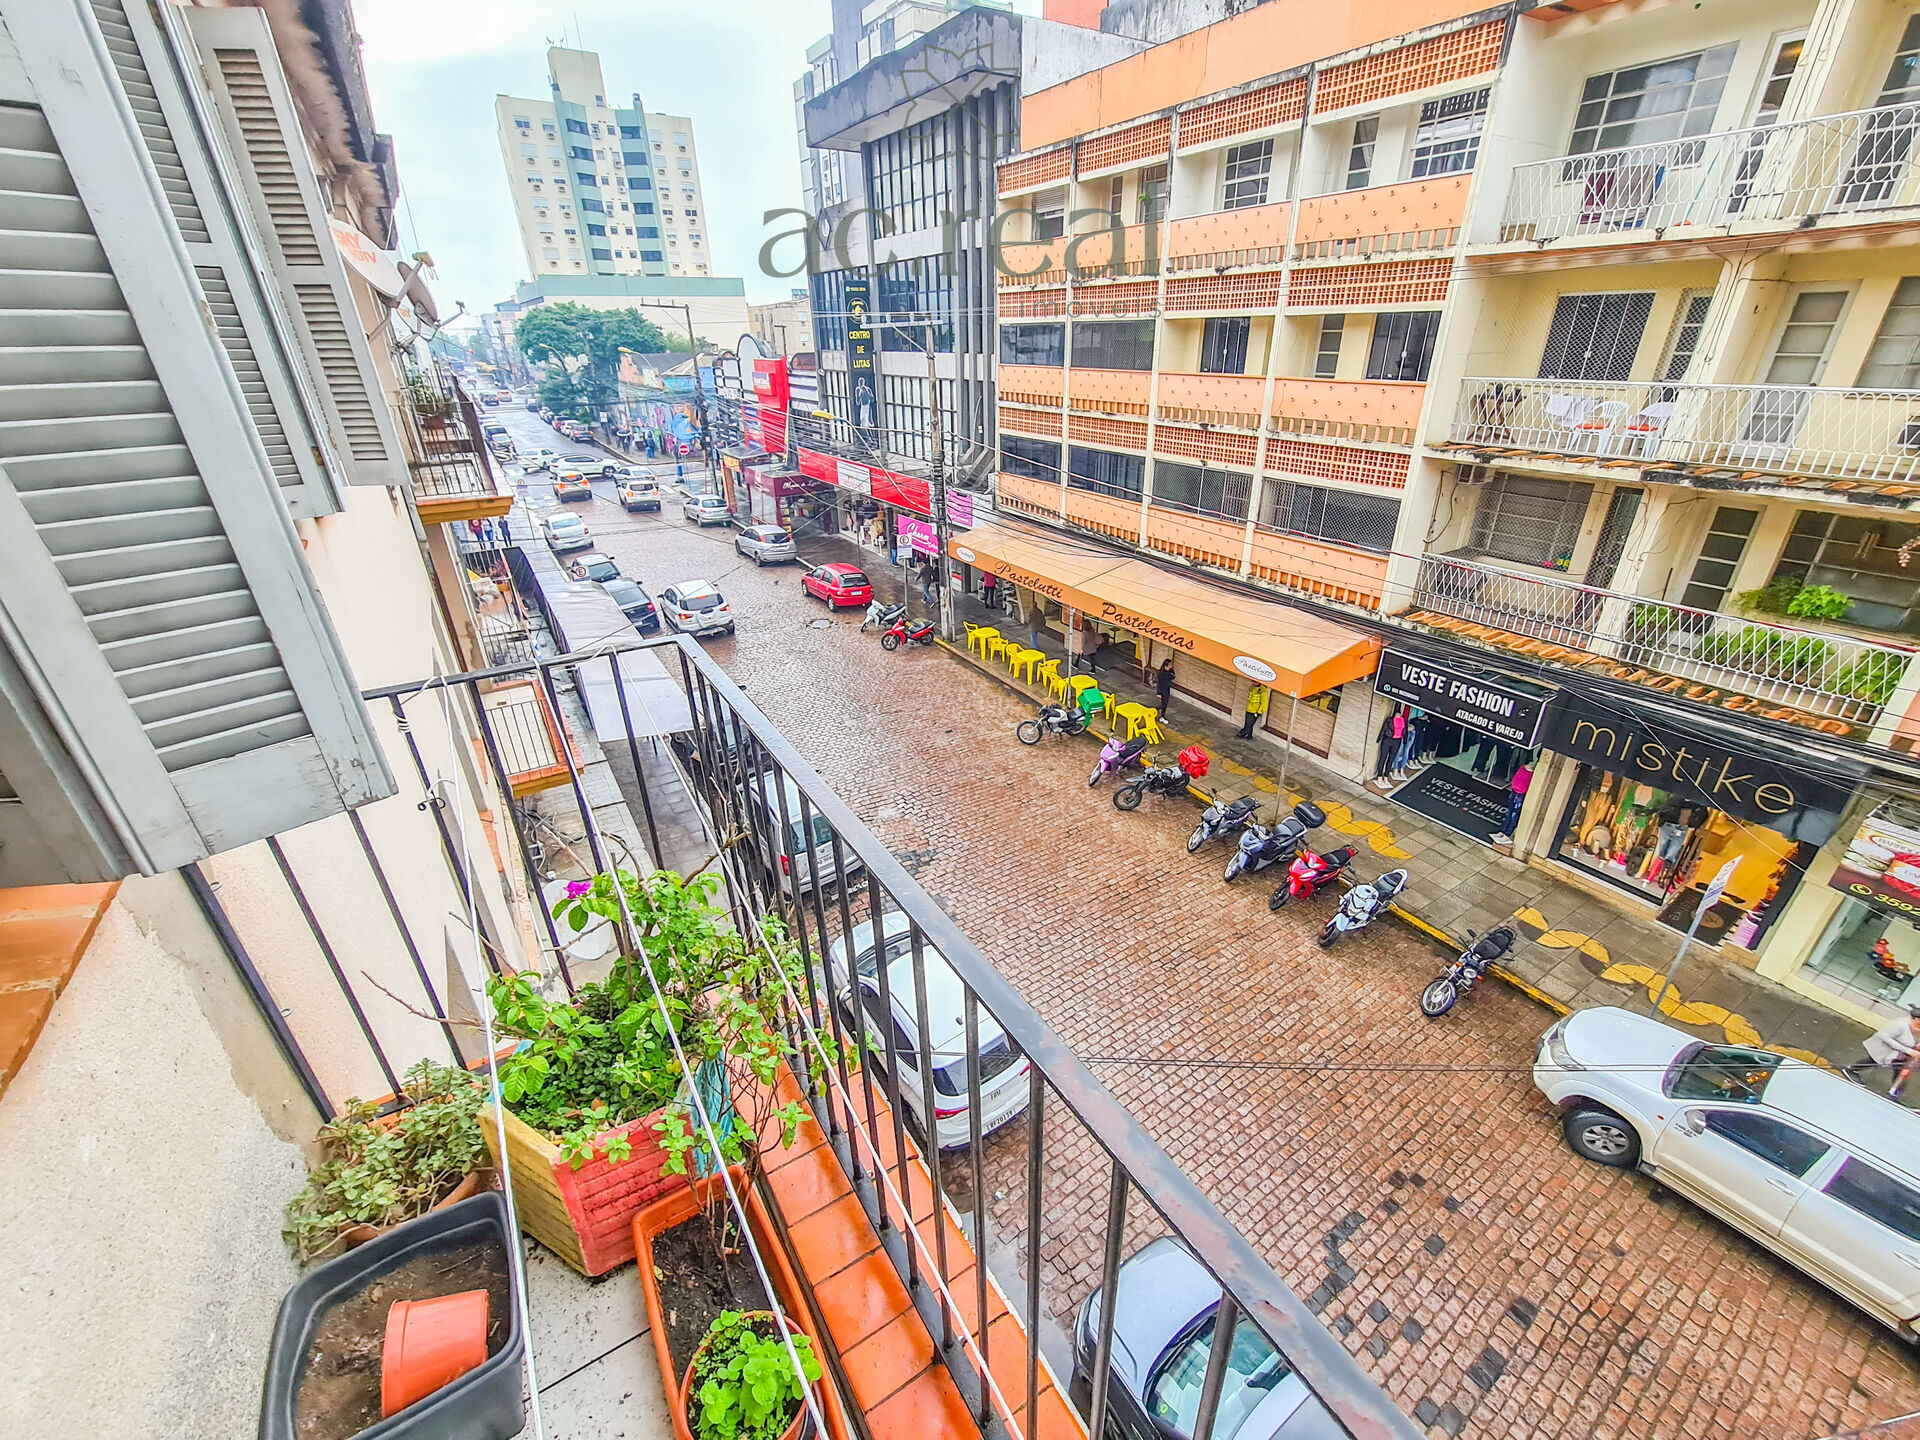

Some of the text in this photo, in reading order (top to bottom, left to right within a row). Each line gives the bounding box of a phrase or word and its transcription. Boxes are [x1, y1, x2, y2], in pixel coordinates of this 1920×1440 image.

[849, 331, 871, 339] CENTRO
[856, 346, 865, 354] DE
[853, 360, 871, 368] LUTAS
[994, 561, 1064, 599] Pastelutti
[1101, 602, 1195, 651] Pastelarias
[1401, 663, 1447, 694] VESTE
[1448, 680, 1515, 717] FASHION
[1455, 709, 1524, 741] ATACADO E VAREJO
[1570, 719, 1795, 814] mistike
[1430, 777, 1467, 797] VESTE
[1465, 792, 1509, 816] FASHIO
